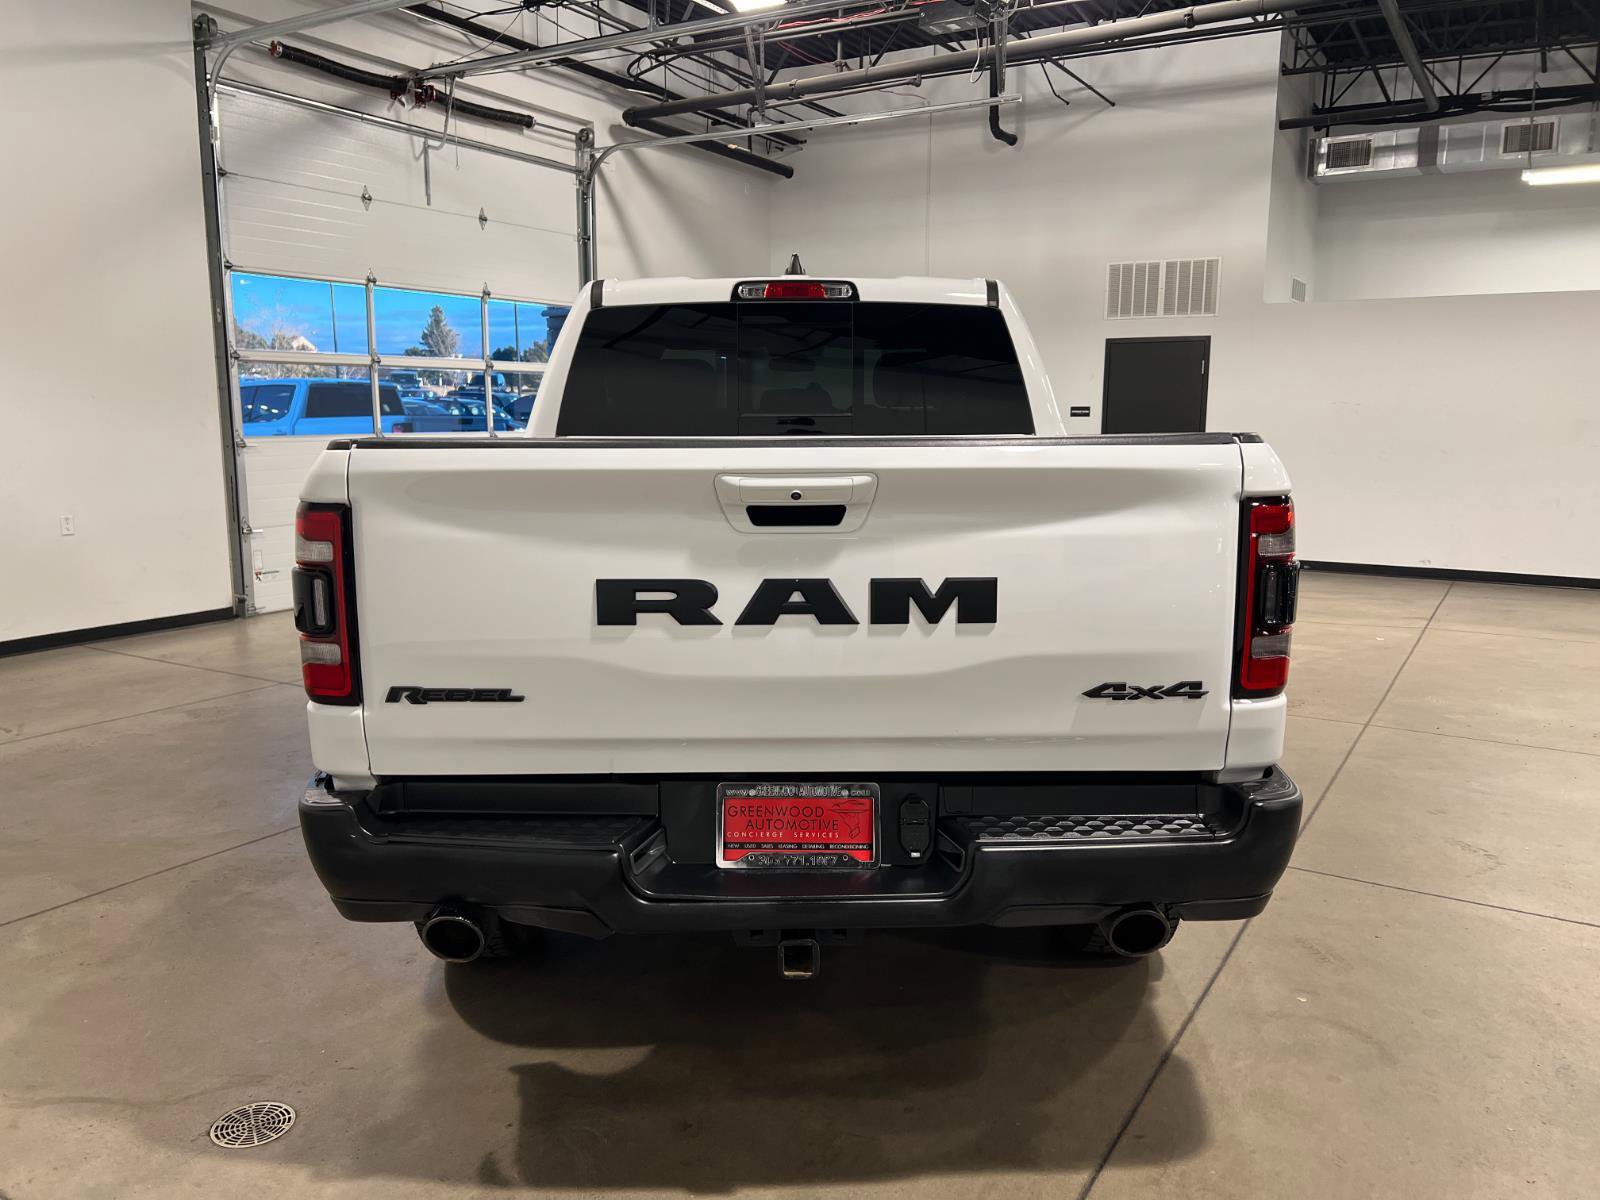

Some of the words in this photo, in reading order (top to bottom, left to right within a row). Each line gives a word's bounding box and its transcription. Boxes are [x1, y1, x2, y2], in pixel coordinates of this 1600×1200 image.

[596, 577, 998, 625] RAM
[385, 686, 525, 704] REBEL
[1081, 680, 1209, 701] 4x4
[727, 805, 825, 818] GREENWOOD
[745, 819, 839, 831] AUTOMOTIVE
